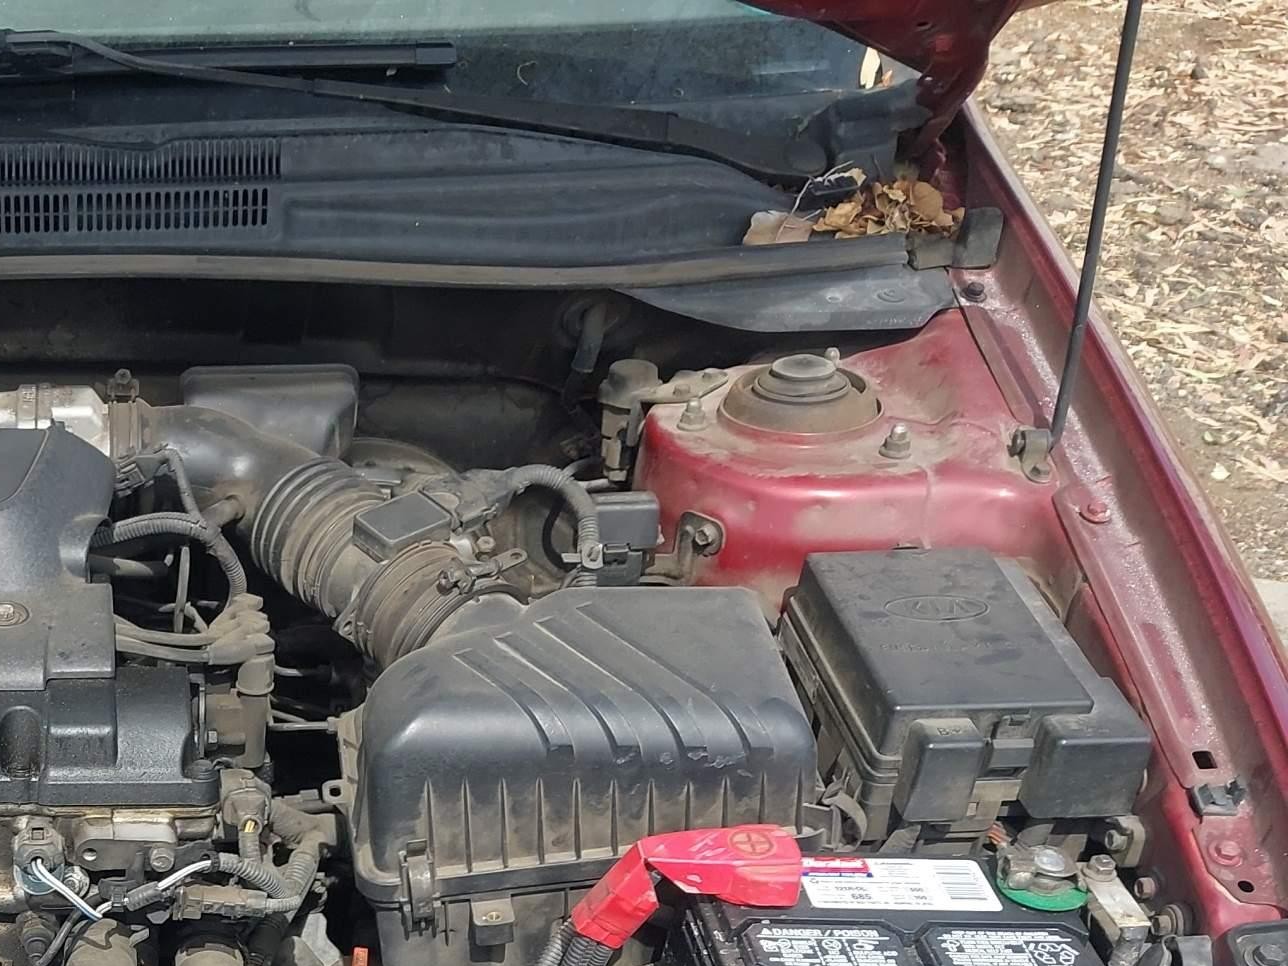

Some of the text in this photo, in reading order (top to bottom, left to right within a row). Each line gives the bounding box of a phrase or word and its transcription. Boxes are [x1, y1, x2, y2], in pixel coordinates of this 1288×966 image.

[851, 893, 873, 901] 685
[772, 927, 822, 937] DANGER
[832, 929, 880, 938] POISON
